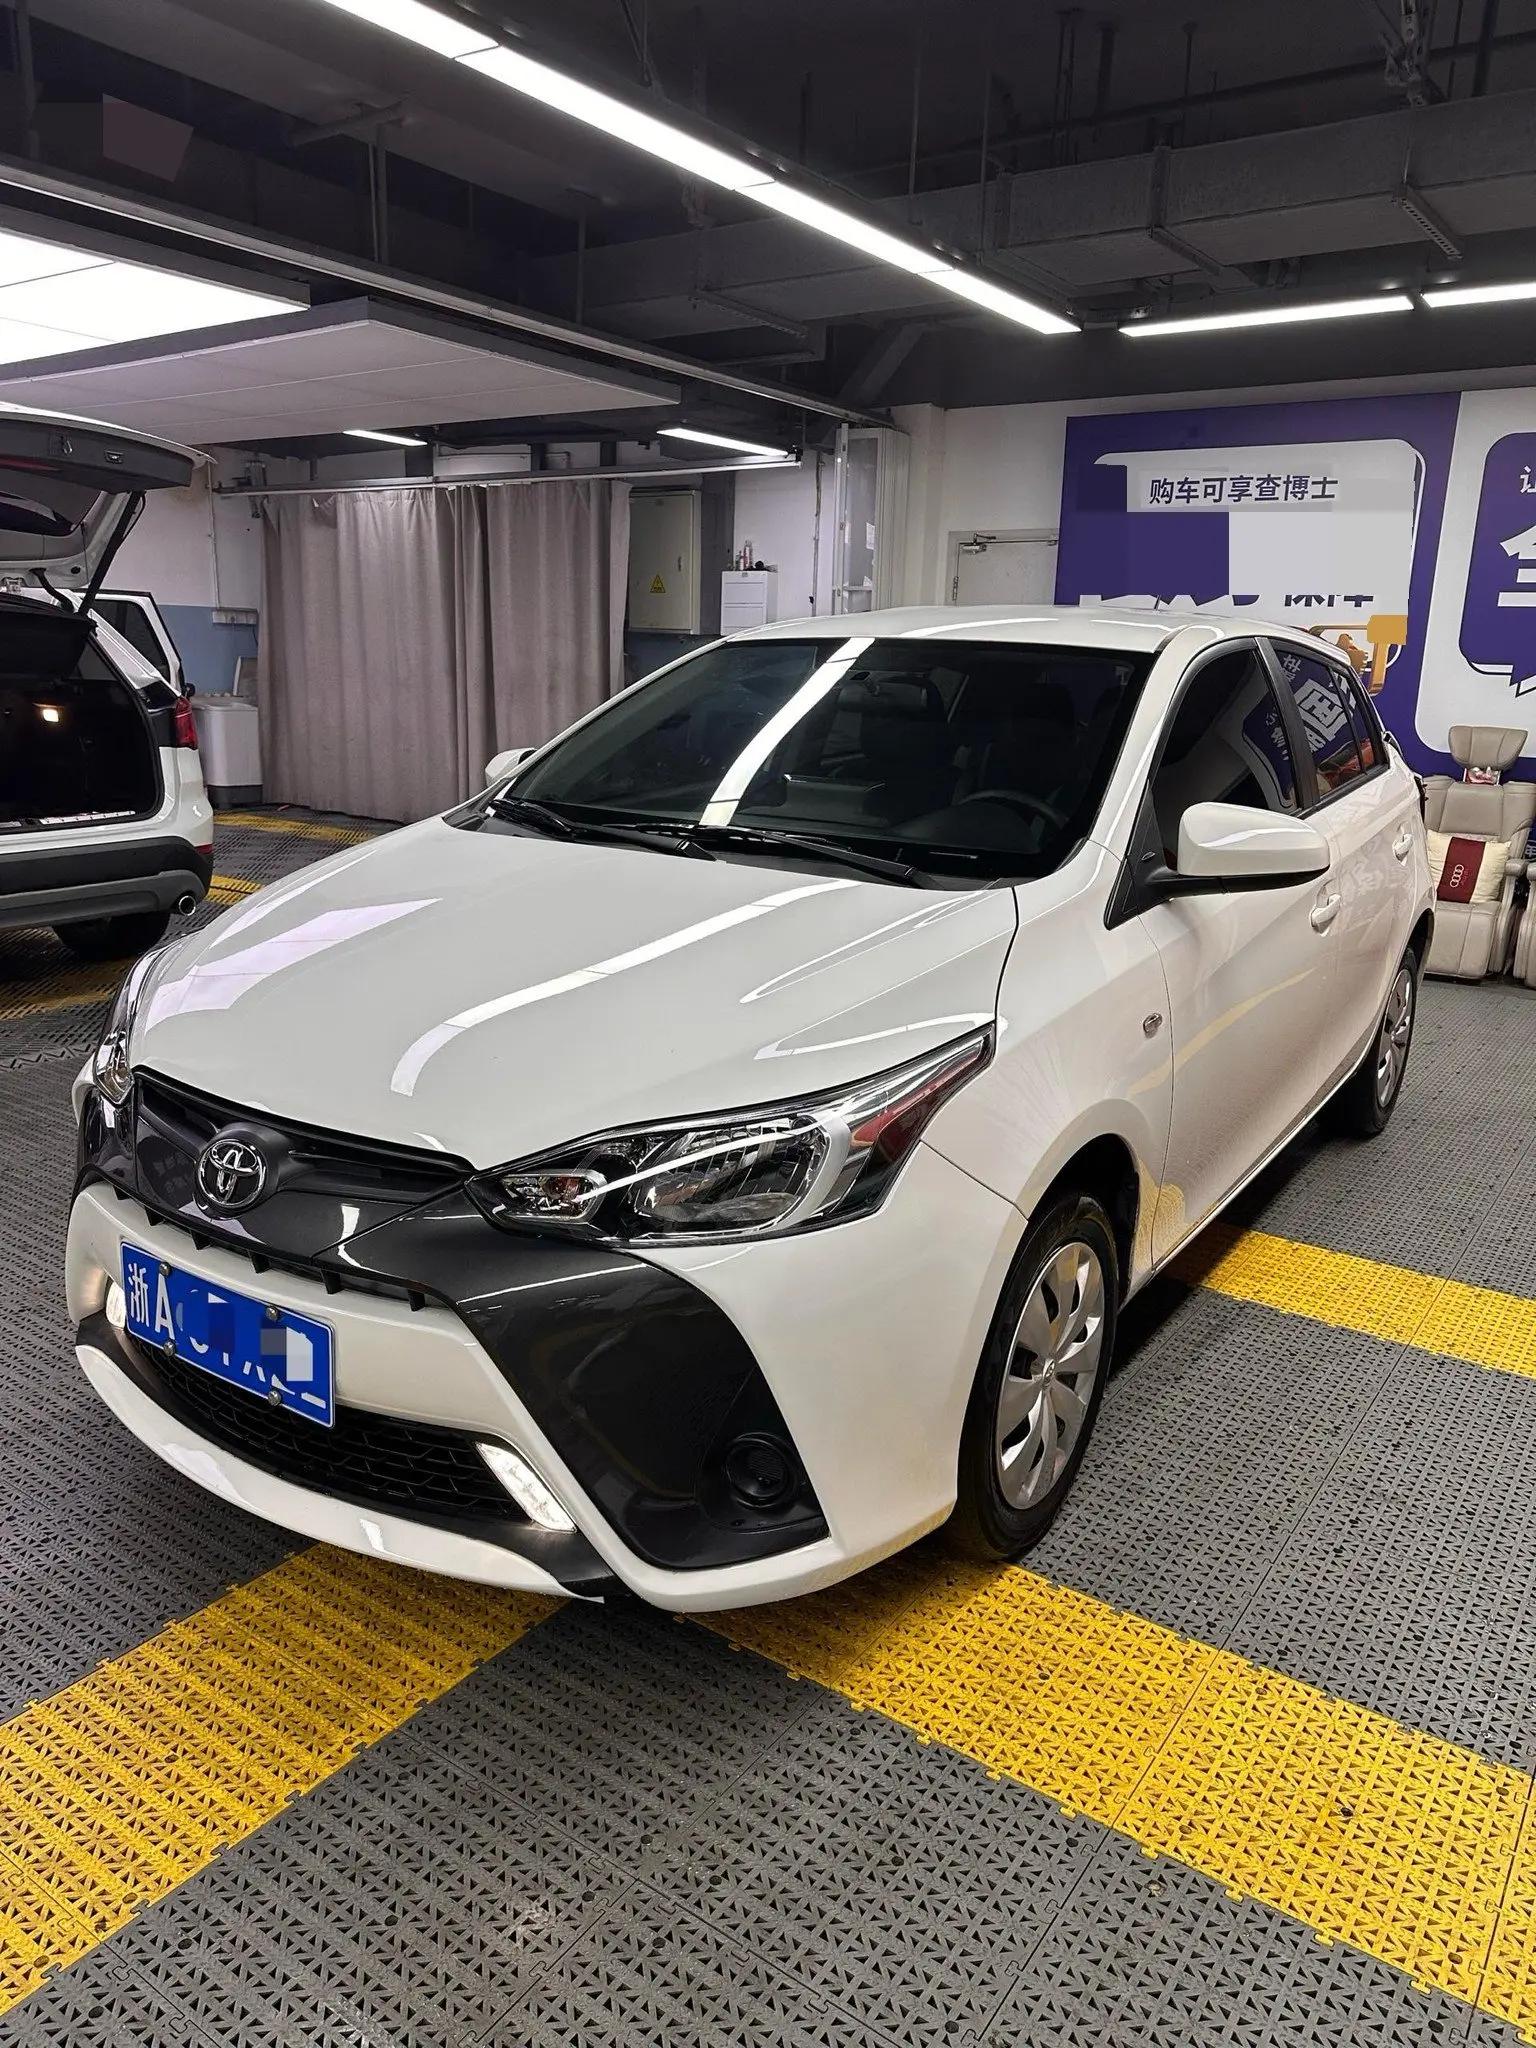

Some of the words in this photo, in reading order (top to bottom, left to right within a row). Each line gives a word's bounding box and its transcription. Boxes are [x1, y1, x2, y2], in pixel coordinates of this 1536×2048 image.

[1149, 473, 1338, 504] 购车可享查博士
